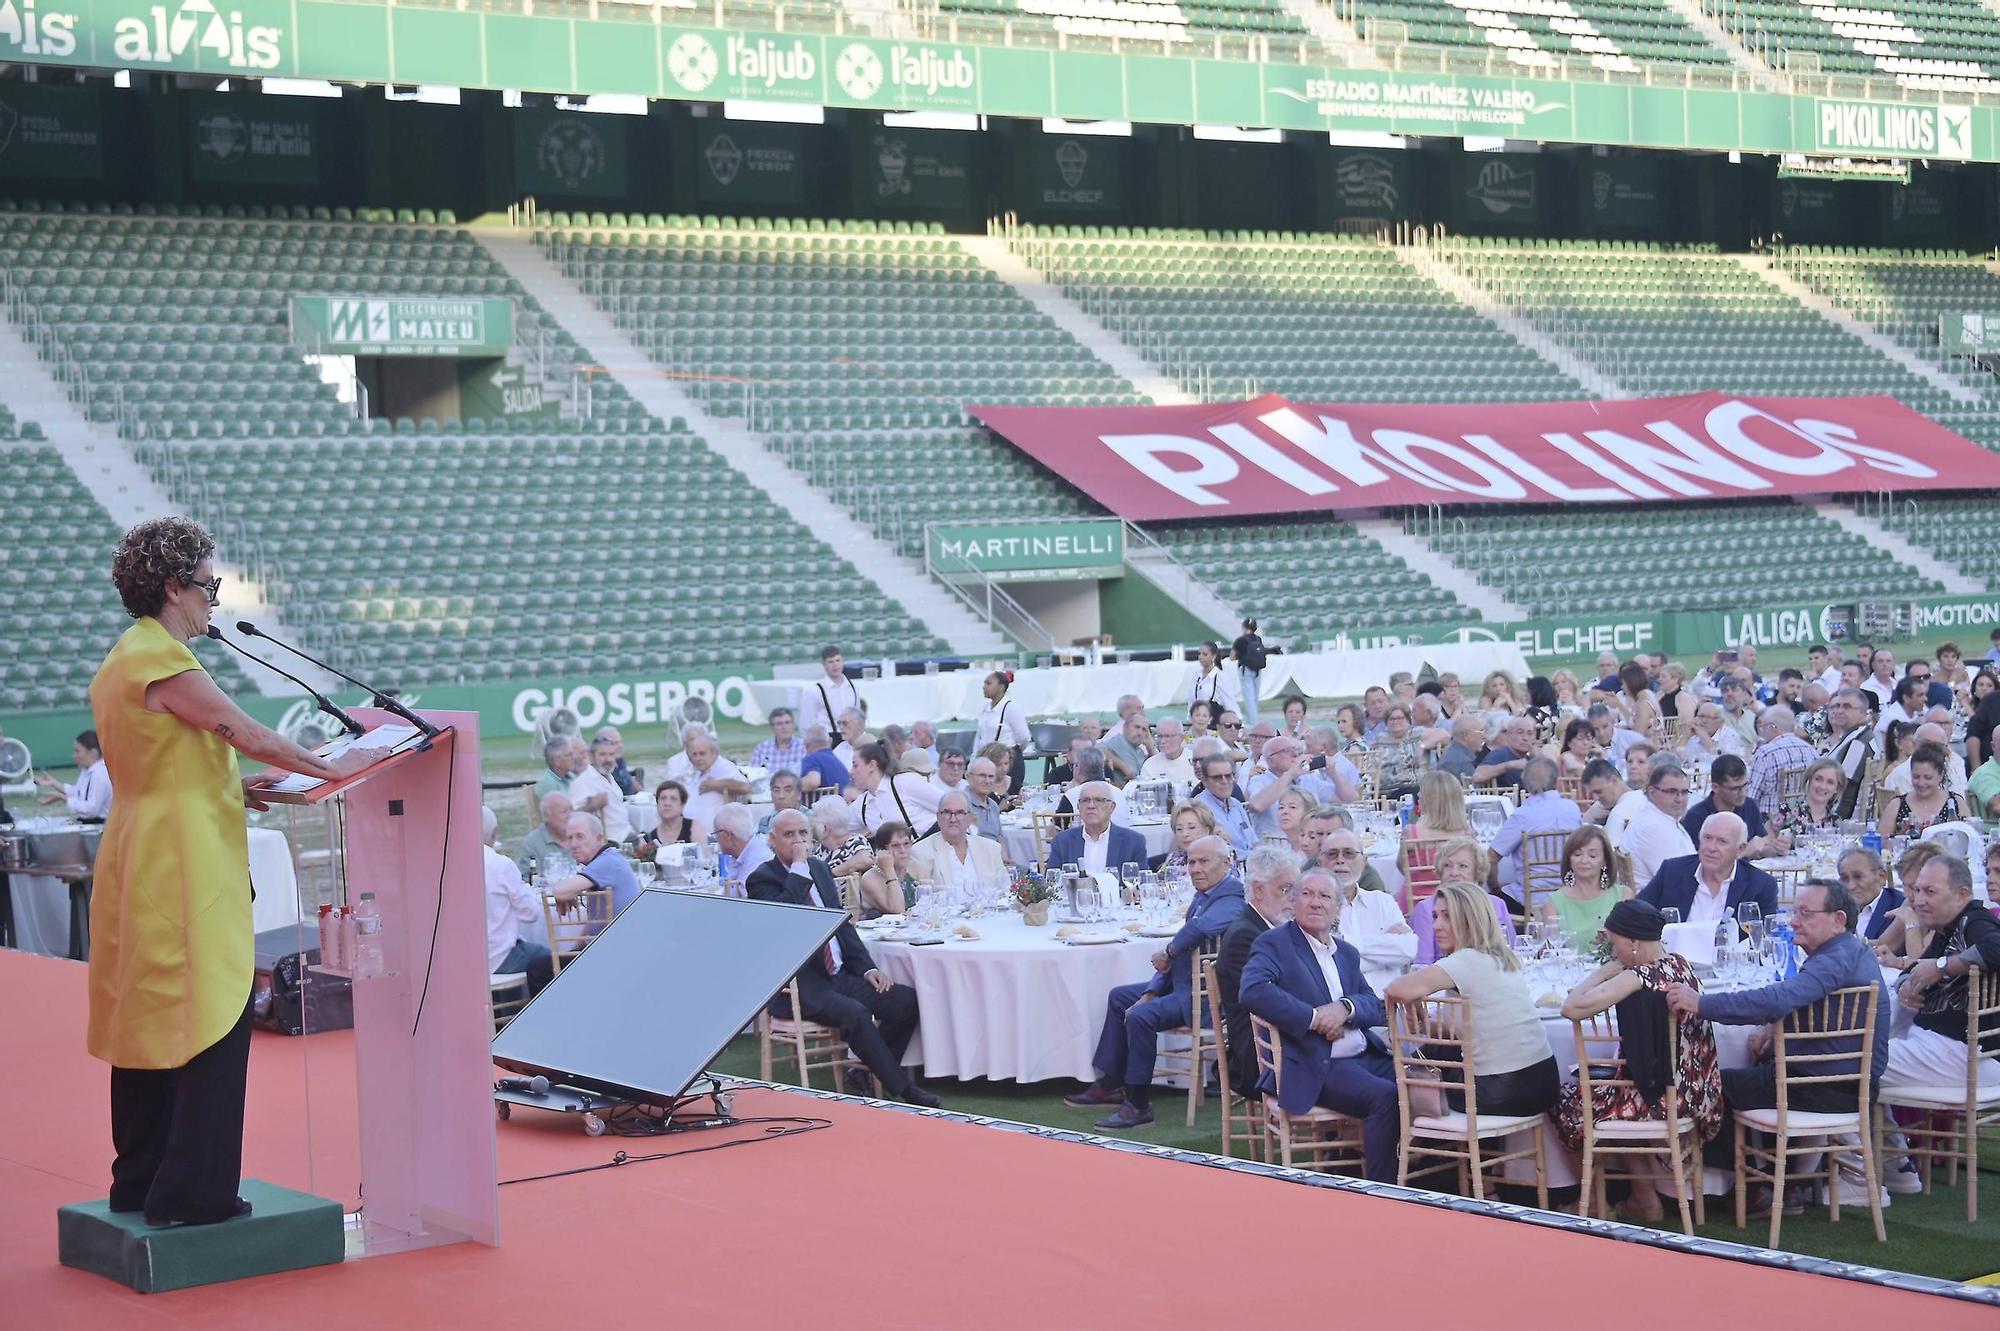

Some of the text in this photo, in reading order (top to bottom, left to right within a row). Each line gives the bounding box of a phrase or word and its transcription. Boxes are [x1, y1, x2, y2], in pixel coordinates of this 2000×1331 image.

[726, 35, 816, 87] l'aljub
[890, 46, 975, 96] l'aljub
[1306, 79, 1536, 110] ESTADIO MARTÍNEZ VALERO
[1821, 103, 1935, 151] PIKOLINOS
[399, 320, 474, 340] MATEU
[502, 387, 542, 415] SALIDA
[1098, 399, 1938, 507] PIKOLINOS
[941, 535, 1113, 559] MARTINELLI
[1515, 622, 1653, 657] ELCHECF
[1723, 609, 1815, 648] LALIGA
